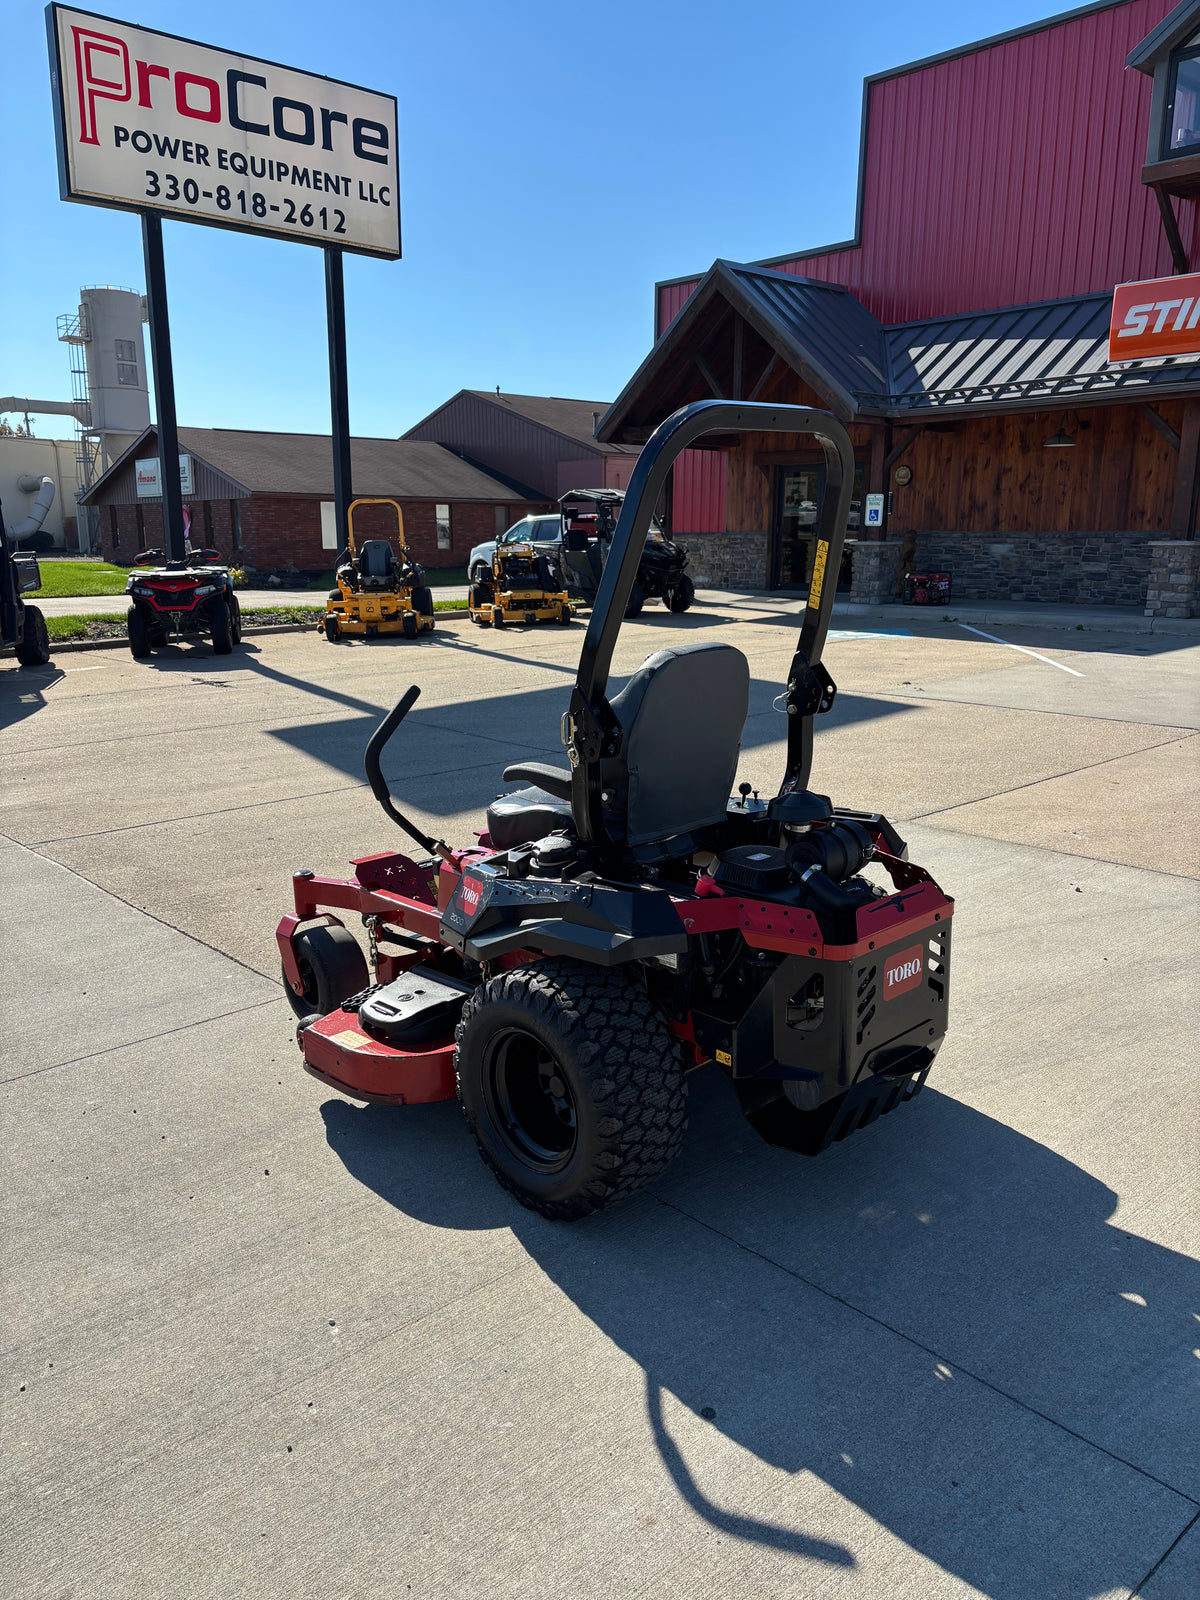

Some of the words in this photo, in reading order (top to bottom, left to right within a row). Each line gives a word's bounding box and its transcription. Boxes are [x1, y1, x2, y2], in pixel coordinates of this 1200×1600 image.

[71, 25, 390, 166] ProCore
[113, 125, 211, 167] POWER
[217, 148, 352, 197] EQUIPMENT
[358, 180, 391, 207] LLC
[145, 170, 347, 234] 330-818-2612
[461, 886, 479, 904] TORO
[886, 958, 920, 986] TORO
